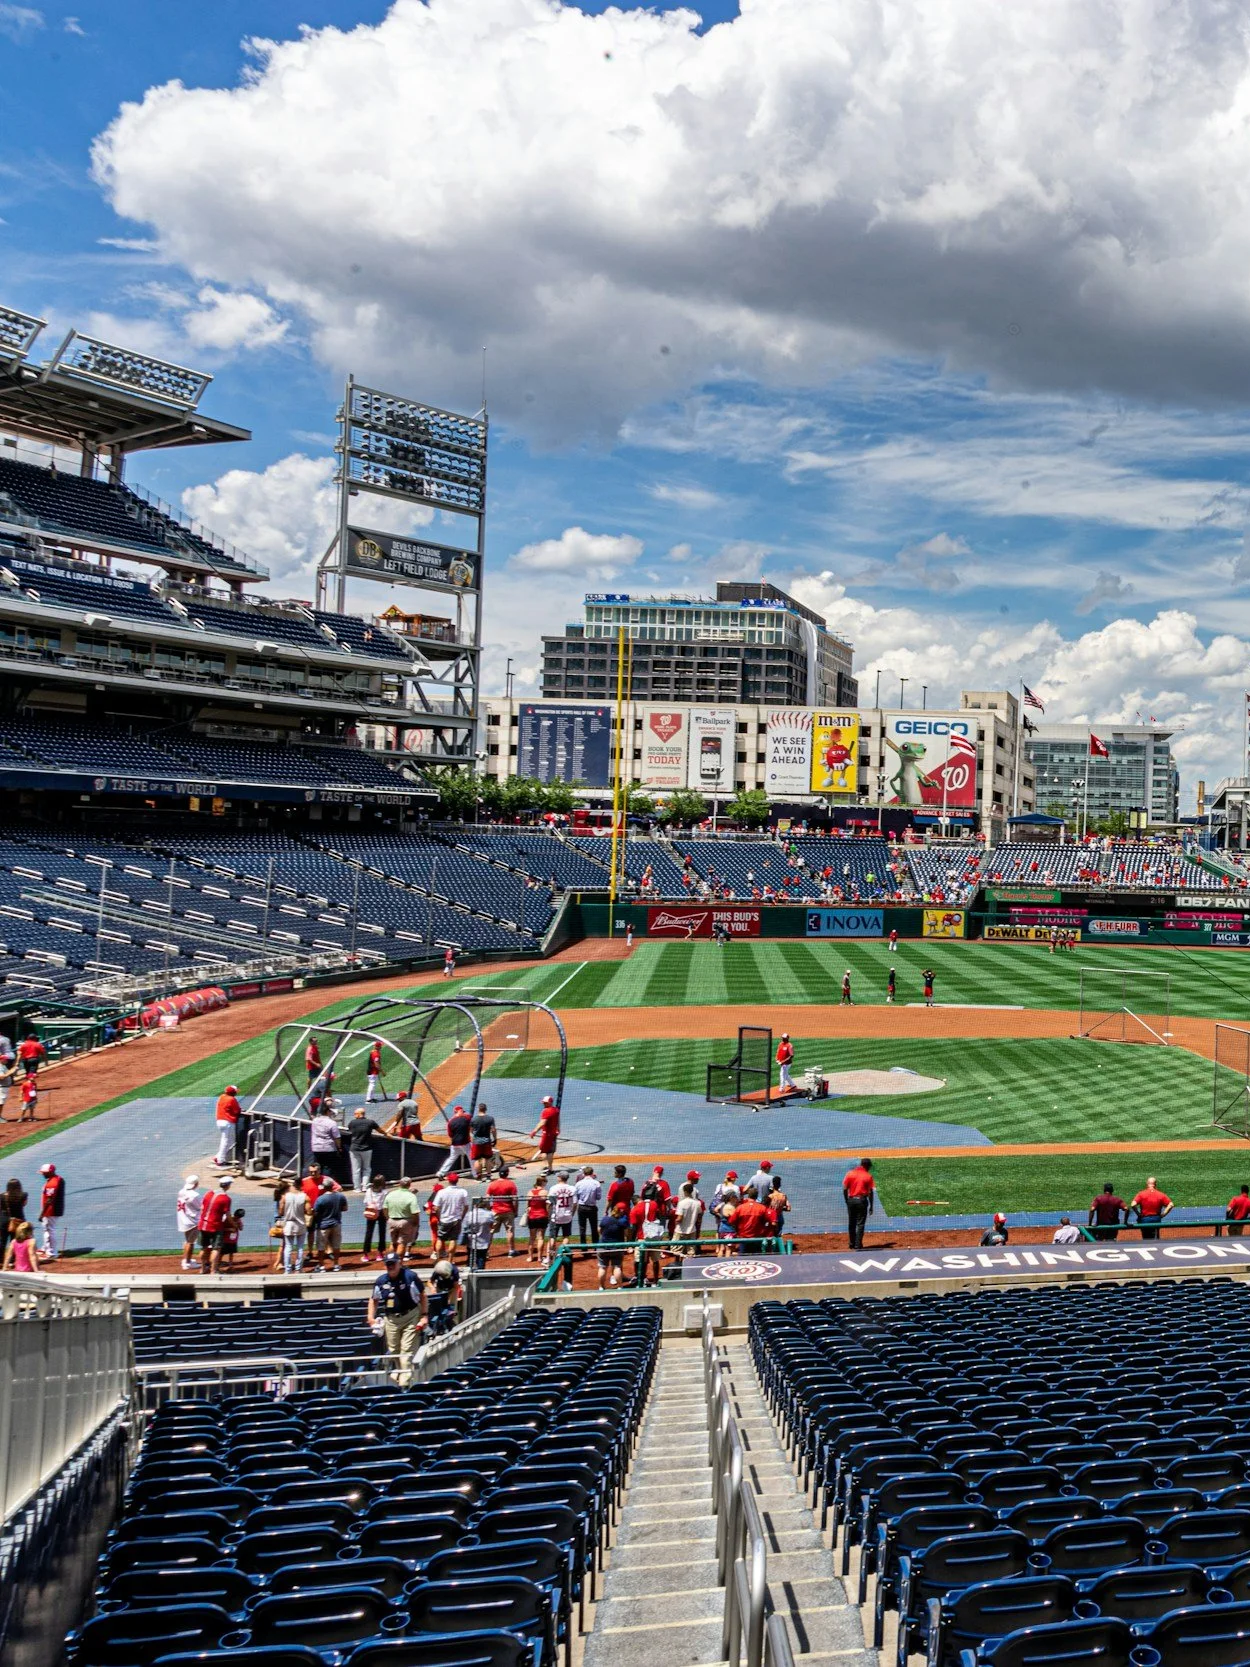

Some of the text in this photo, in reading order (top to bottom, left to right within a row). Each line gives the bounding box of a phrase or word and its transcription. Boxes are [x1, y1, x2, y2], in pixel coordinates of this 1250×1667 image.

[392, 541, 441, 557] DEVILS BACKBONE
[390, 549, 415, 561] BREWING
[416, 553, 442, 566] COMPANY
[383, 559, 402, 571] LEFT
[403, 562, 423, 576] FIELD
[424, 566, 448, 580] LODGE
[104, 577, 113, 586] TO
[702, 716, 731, 725] Ballpark
[895, 720, 969, 736] GEICO
[771, 736, 807, 746] WE SEE
[773, 746, 805, 755] A WIN
[647, 755, 682, 765] TODAY
[771, 756, 806, 765] AHEAD
[111, 779, 149, 792] TASTE
[149, 783, 159, 791] OF
[160, 783, 174, 792] THE
[175, 782, 217, 796] WORLD
[320, 791, 354, 803] TASTE
[376, 794, 412, 806] WORLD
[1150, 896, 1166, 904] 2:16
[1214, 897, 1250, 908] FAN
[712, 911, 760, 922] THIS BUD'S
[730, 922, 750, 932] YOU.
[826, 915, 882, 930] INOVA
[1034, 929, 1079, 939] DEWT
[1216, 933, 1240, 941] MGM
[557, 1196, 570, 1208] 31
